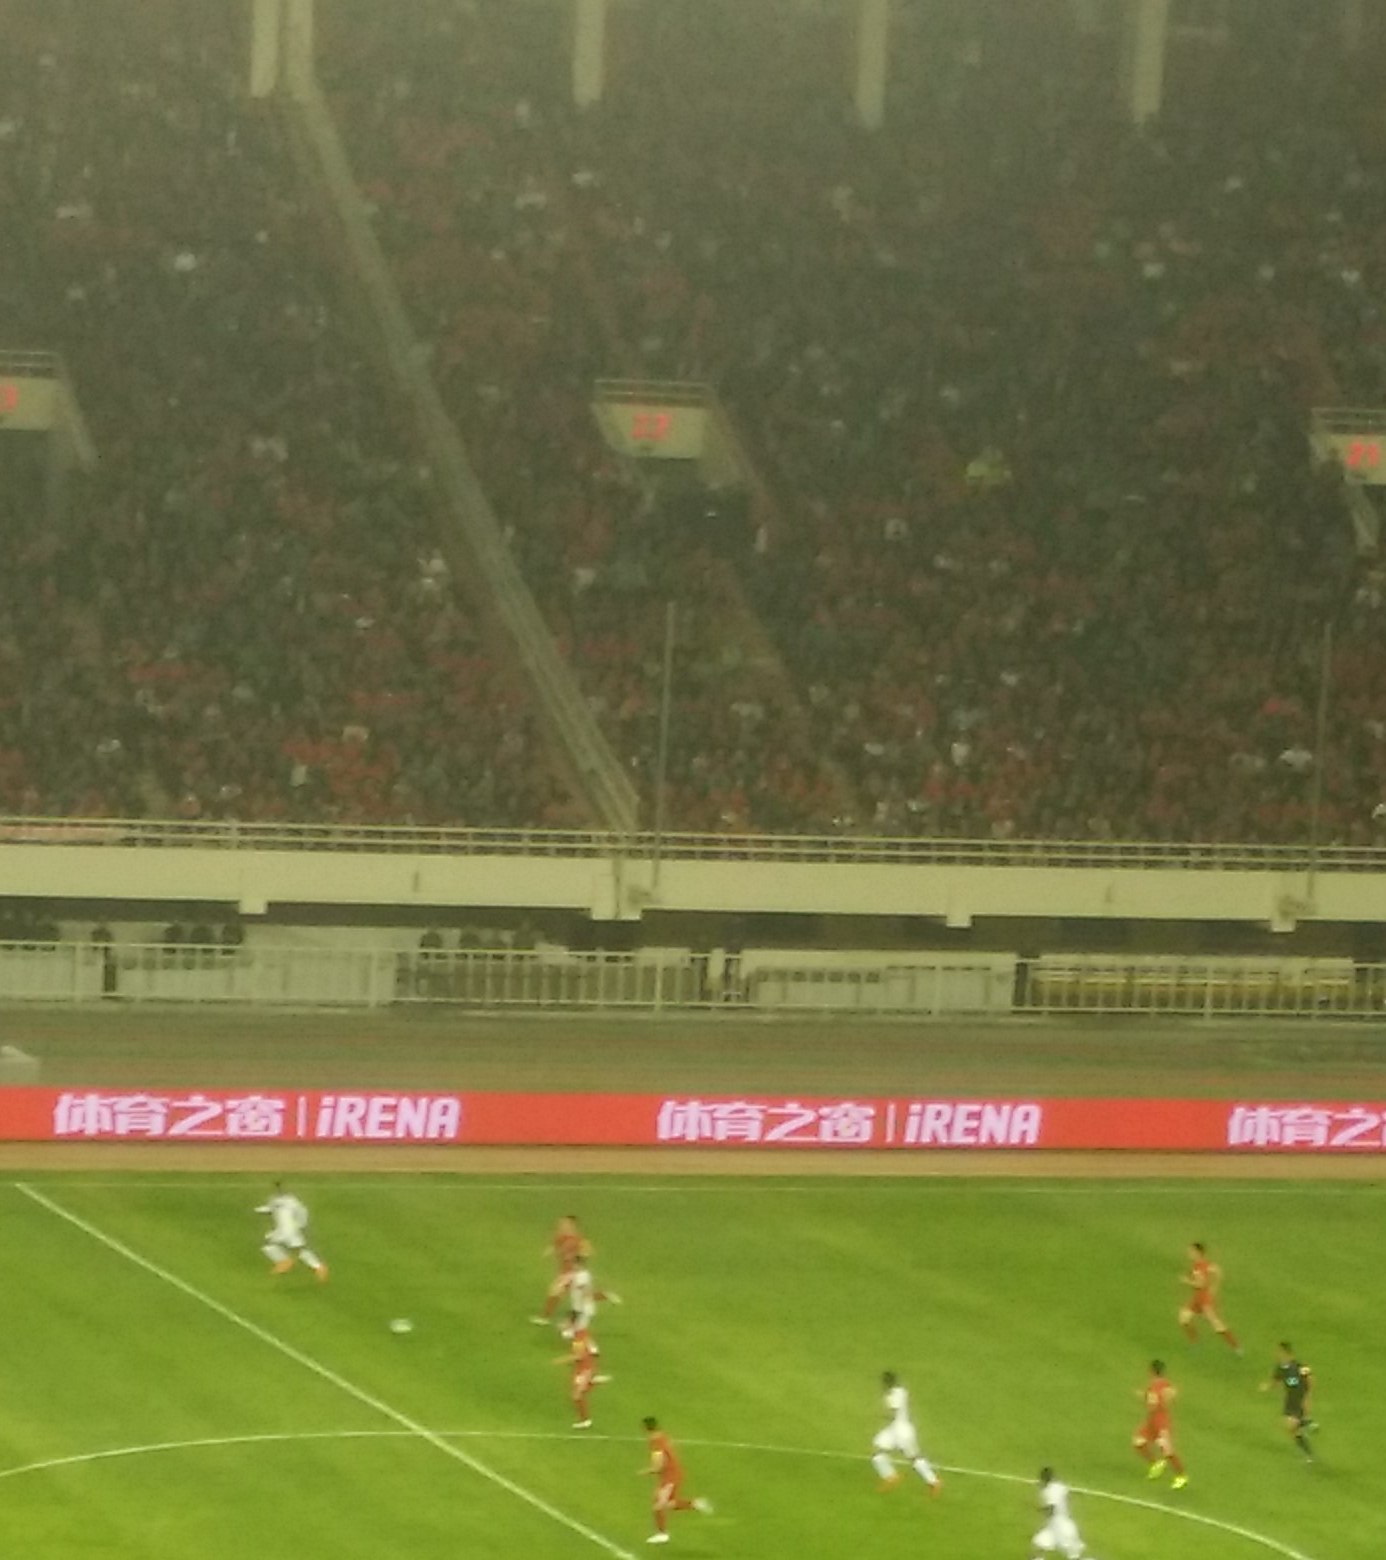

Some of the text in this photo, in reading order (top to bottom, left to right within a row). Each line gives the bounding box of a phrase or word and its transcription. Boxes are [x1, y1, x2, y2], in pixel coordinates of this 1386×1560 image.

[53, 1092, 286, 1138] 体育之窗
[656, 1099, 876, 1143] 体育之窗
